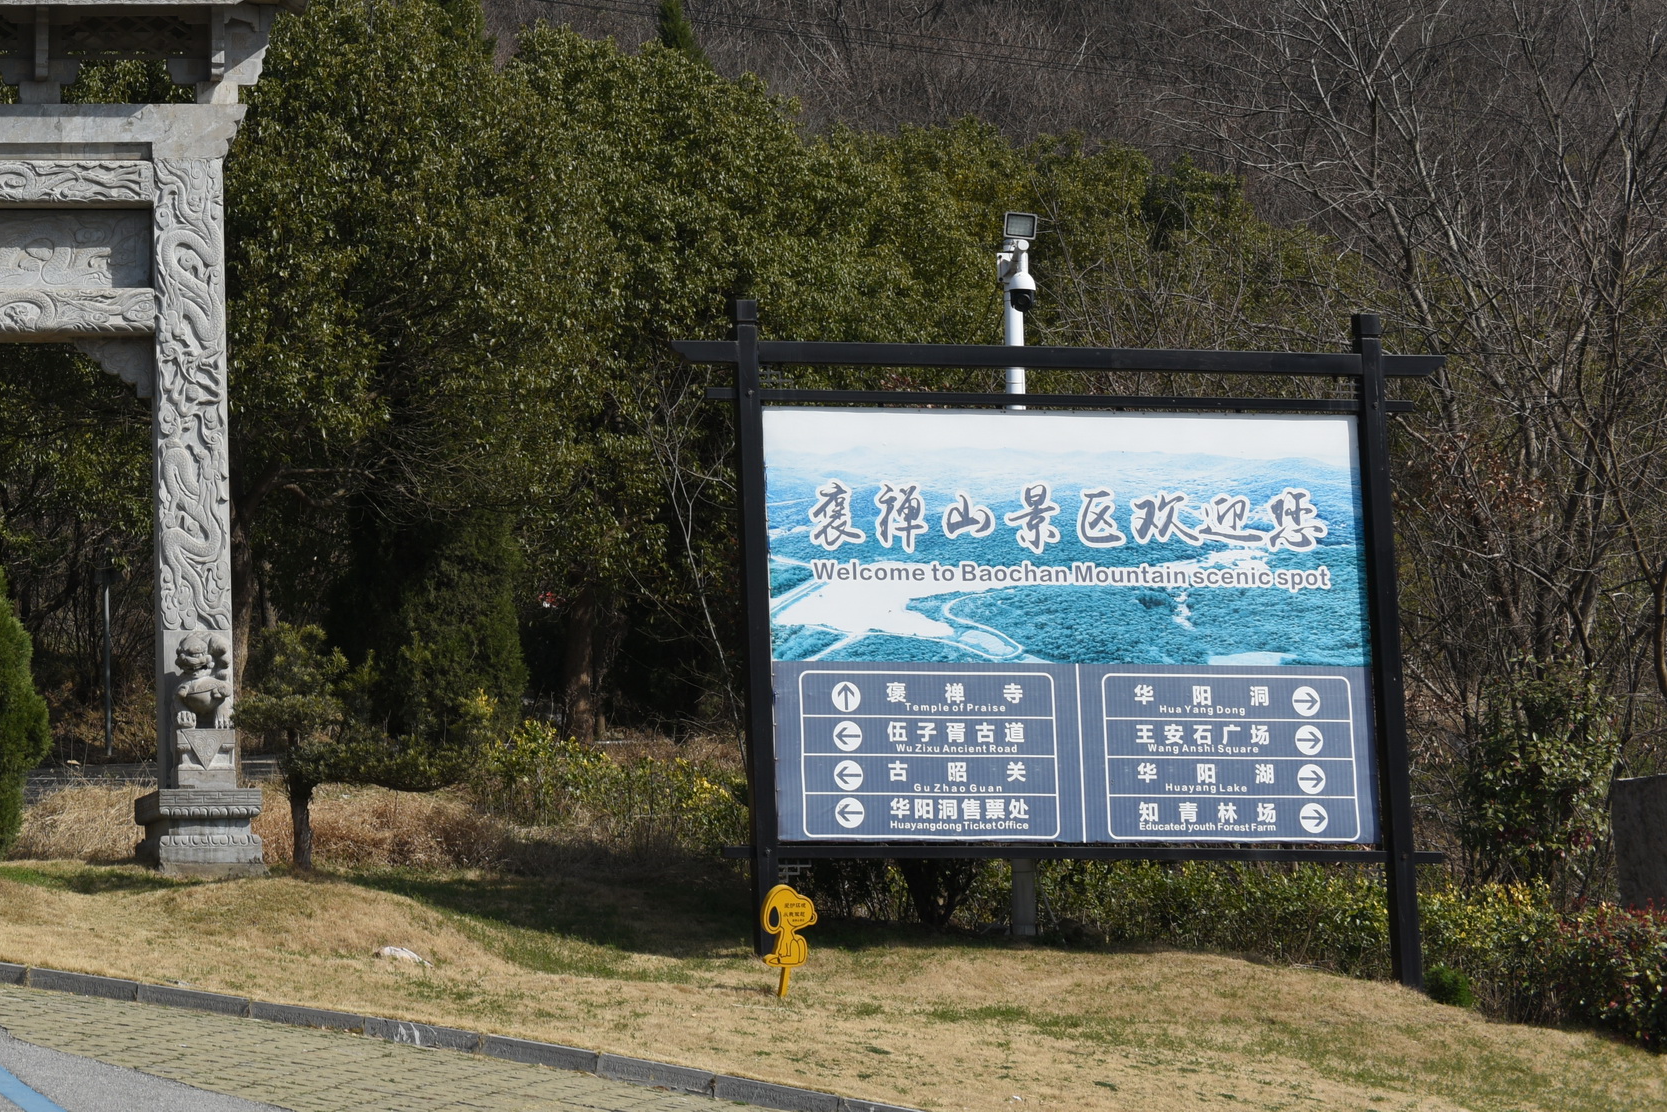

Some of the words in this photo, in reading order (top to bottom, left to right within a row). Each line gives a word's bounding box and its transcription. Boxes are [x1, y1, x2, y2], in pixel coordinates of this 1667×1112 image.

[812, 482, 1327, 551] 褒禅山景区欢迎您
[813, 562, 926, 581] Welcome
[932, 563, 955, 582] to
[961, 563, 1068, 583] Baochan
[1074, 565, 1186, 585] Mountain
[1191, 567, 1272, 586] scenic
[1277, 568, 1329, 590] spot
[886, 682, 1024, 704] 褒禅寺
[1134, 684, 1270, 706] 华阳洞
[904, 703, 949, 714] Temple
[952, 703, 965, 712] of
[966, 703, 1006, 713] Praise
[1159, 705, 1182, 714] Hua
[1184, 705, 1214, 716] Yang
[1216, 706, 1246, 716] Dong
[887, 721, 1025, 743] 伍子胥古道
[1135, 724, 1270, 745] 王安石广场
[895, 744, 913, 753] Wu
[914, 744, 940, 753] Zixu
[942, 744, 987, 753] Ancient
[989, 744, 1018, 753] Road
[1147, 744, 1179, 755] Wang
[1181, 744, 1215, 753] Anshi
[1217, 744, 1259, 755] Square
[888, 760, 1026, 782] 古昭关
[1137, 762, 1275, 784] 华阳湖
[913, 783, 930, 792] Gu
[933, 783, 966, 793] Zhao
[969, 784, 1003, 793] Guan
[1165, 783, 1216, 794] Huayang
[1219, 783, 1248, 793] Lake
[890, 798, 1030, 819] 华阳洞售票处
[1138, 801, 1277, 823] 知青林场
[890, 821, 962, 832] Huayangdong
[963, 821, 997, 830] Ticket
[997, 821, 1029, 830] Office
[1139, 821, 1186, 831] Educated
[1187, 822, 1216, 833] youth
[1217, 822, 1250, 832] Forest
[1251, 823, 1277, 832] Farm
